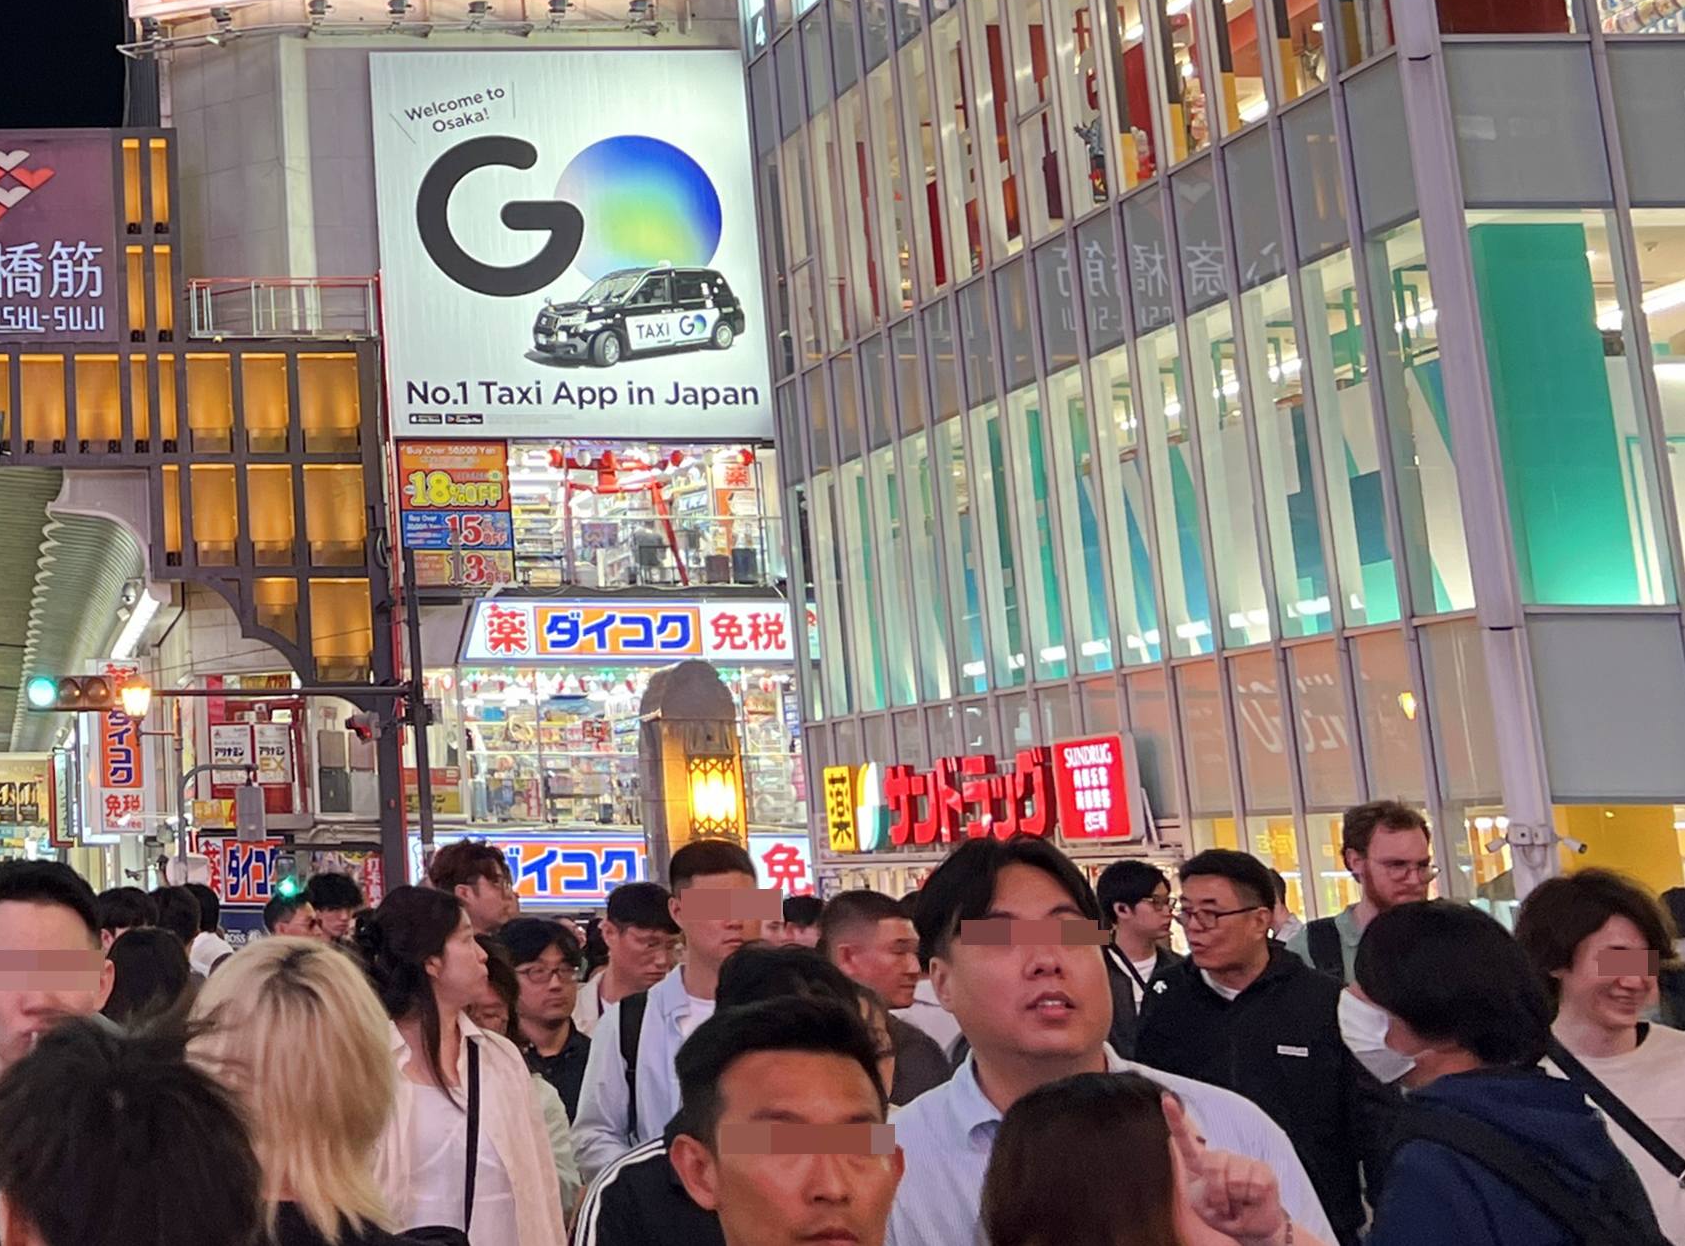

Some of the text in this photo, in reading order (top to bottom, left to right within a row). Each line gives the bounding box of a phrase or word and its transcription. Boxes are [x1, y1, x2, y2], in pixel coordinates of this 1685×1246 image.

[404, 86, 506, 123] Welcome to
[432, 107, 490, 134] Osaka!
[416, 135, 723, 298] GO
[636, 314, 707, 340] TAXI GO
[406, 380, 760, 411] No.1 Taxi App in Japan
[485, 603, 788, 655] 薬 ダイコク 免税
[259, 756, 285, 772] EX
[1063, 743, 1113, 769] SUNDRUG
[883, 745, 1057, 847] サンドラッグ
[228, 844, 281, 897] ダイコ
